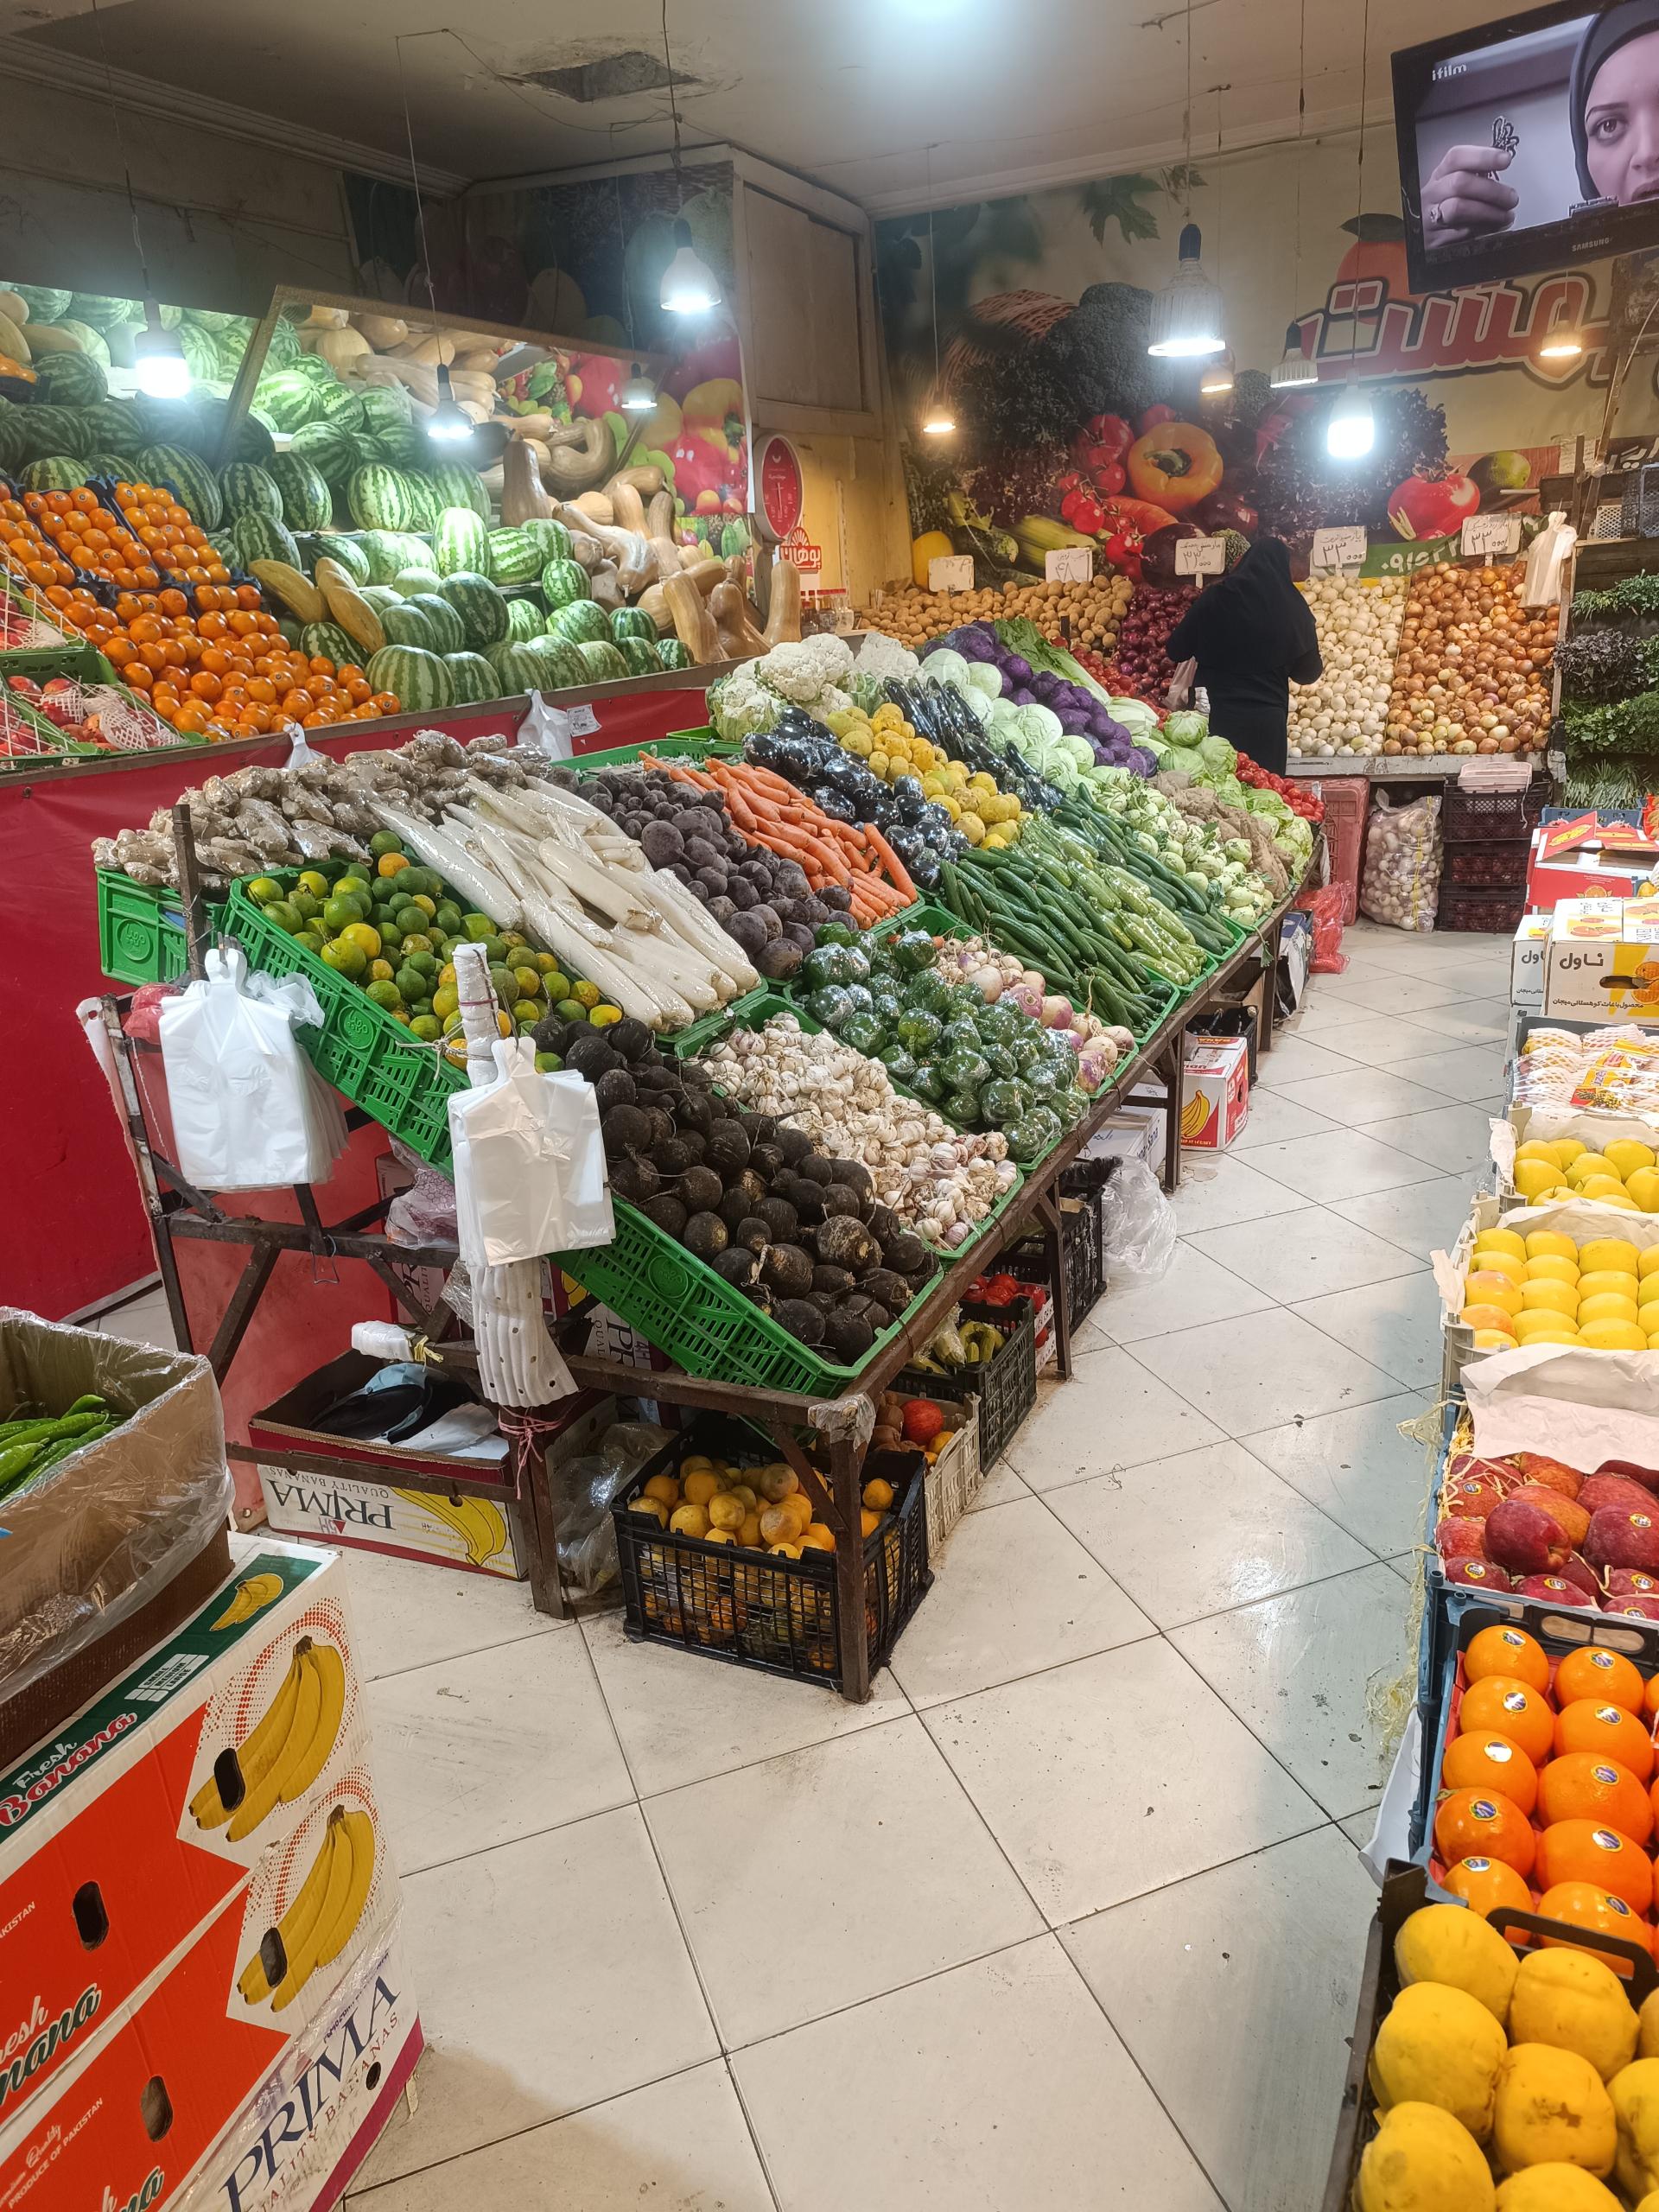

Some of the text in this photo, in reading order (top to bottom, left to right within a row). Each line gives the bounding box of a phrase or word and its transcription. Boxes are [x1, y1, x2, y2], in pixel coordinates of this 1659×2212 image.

[1432, 64, 1467, 81] ifilm
[1572, 238, 1610, 252] SAMSUNG
[1521, 950, 1545, 965] اول
[1559, 952, 1605, 970] ناول
[422, 1267, 434, 1313] QUALIT
[264, 1478, 397, 1533] PRIMA
[330, 1480, 390, 1499] QUALITY
[143, 1667, 170, 1686] SMALL
[154, 1662, 187, 1687] MEDIUM
[166, 1669, 192, 1688] LARGE
[0, 1712, 138, 1827] Banana
[12, 1741, 78, 1789] Fresh
[0, 1901, 36, 1939] AKISTAN
[0, 1995, 49, 2064] resh
[0, 1982, 103, 2107] nana
[218, 1975, 402, 2212] PRIMA
[9, 2097, 105, 2210] PRODUCE OF PAKISTAN
[26, 2123, 62, 2170] Quality
